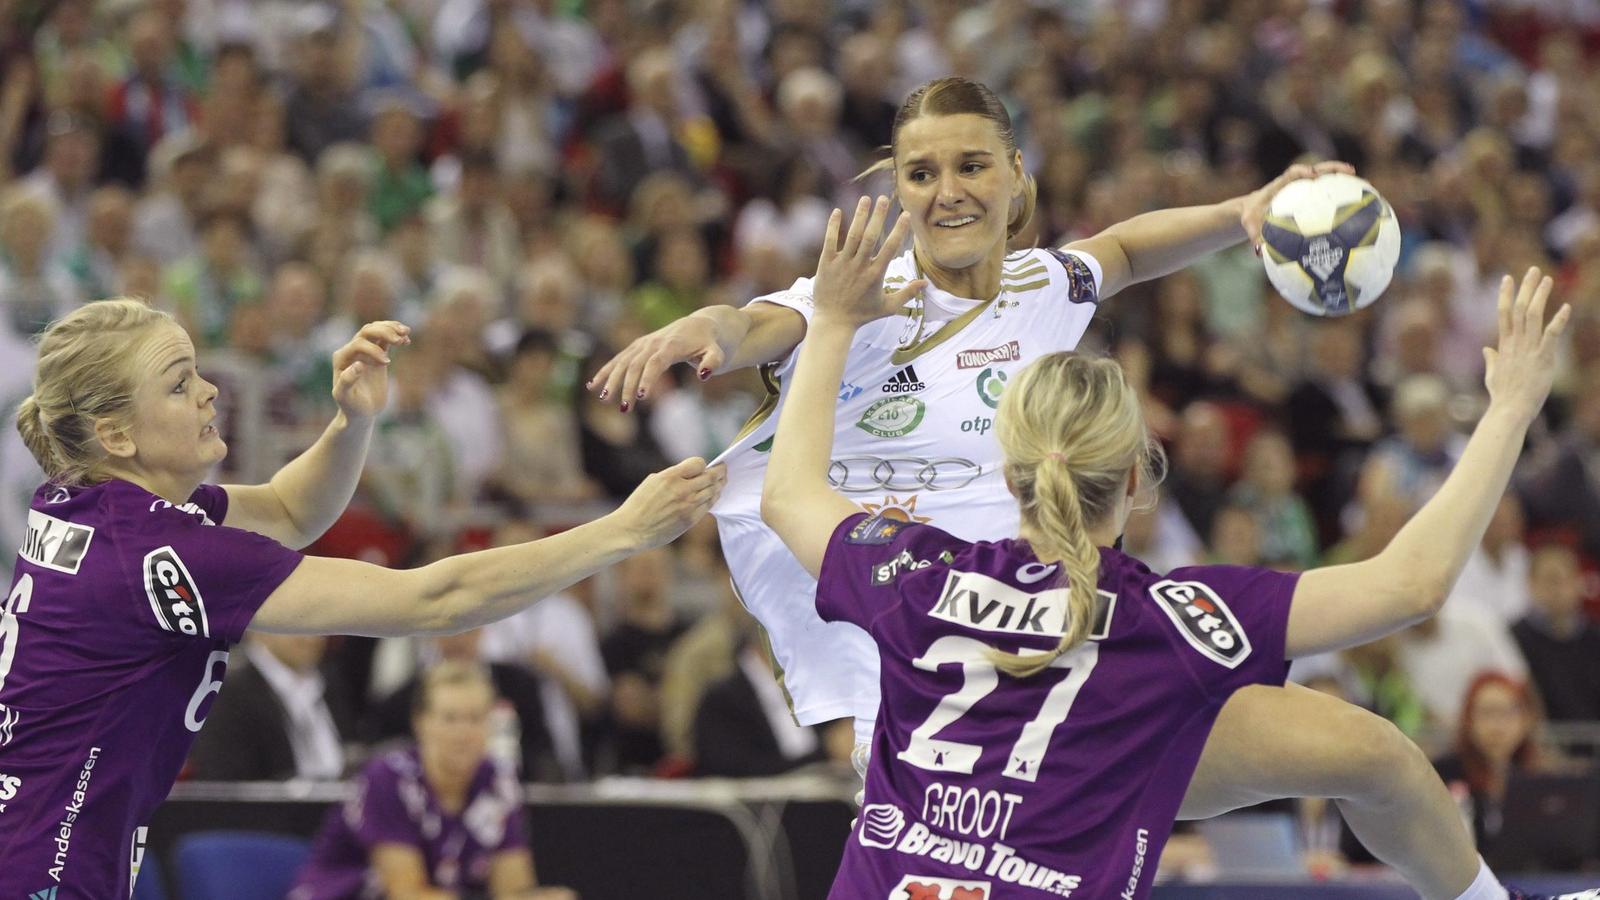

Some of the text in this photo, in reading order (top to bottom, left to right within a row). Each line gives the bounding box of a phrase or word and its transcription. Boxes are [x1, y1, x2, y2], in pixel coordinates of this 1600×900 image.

[882, 381, 926, 393] adidas
[960, 416, 992, 435] otp
[939, 575, 1051, 632] kvik
[897, 635, 1099, 783] 27
[48, 747, 102, 882] Andelskassen
[922, 782, 1023, 840] GROOT
[896, 821, 1082, 891] Bravo Tours
